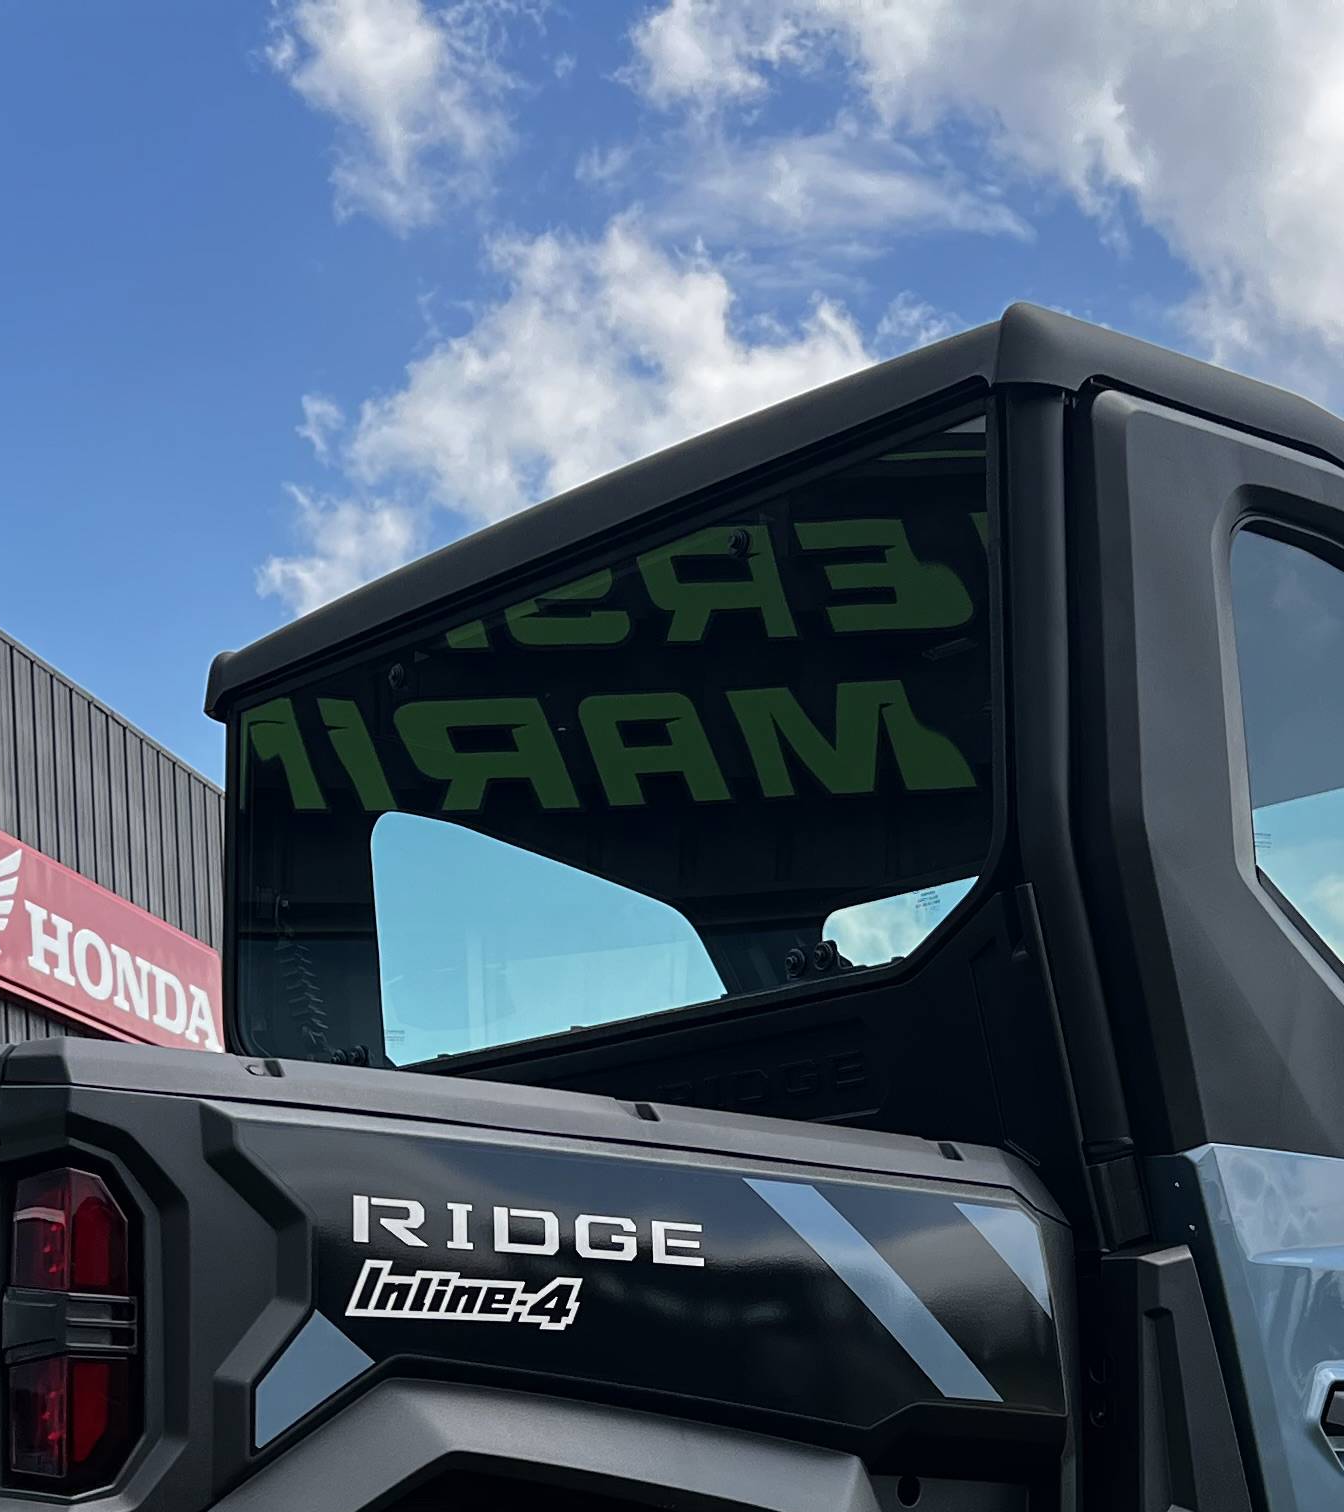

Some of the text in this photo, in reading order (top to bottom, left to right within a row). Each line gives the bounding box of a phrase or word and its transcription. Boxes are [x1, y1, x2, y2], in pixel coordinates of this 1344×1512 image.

[24, 899, 225, 1053] HONDA
[352, 1194, 705, 1267] RIDGE
[345, 1258, 583, 1331] Inline-4
